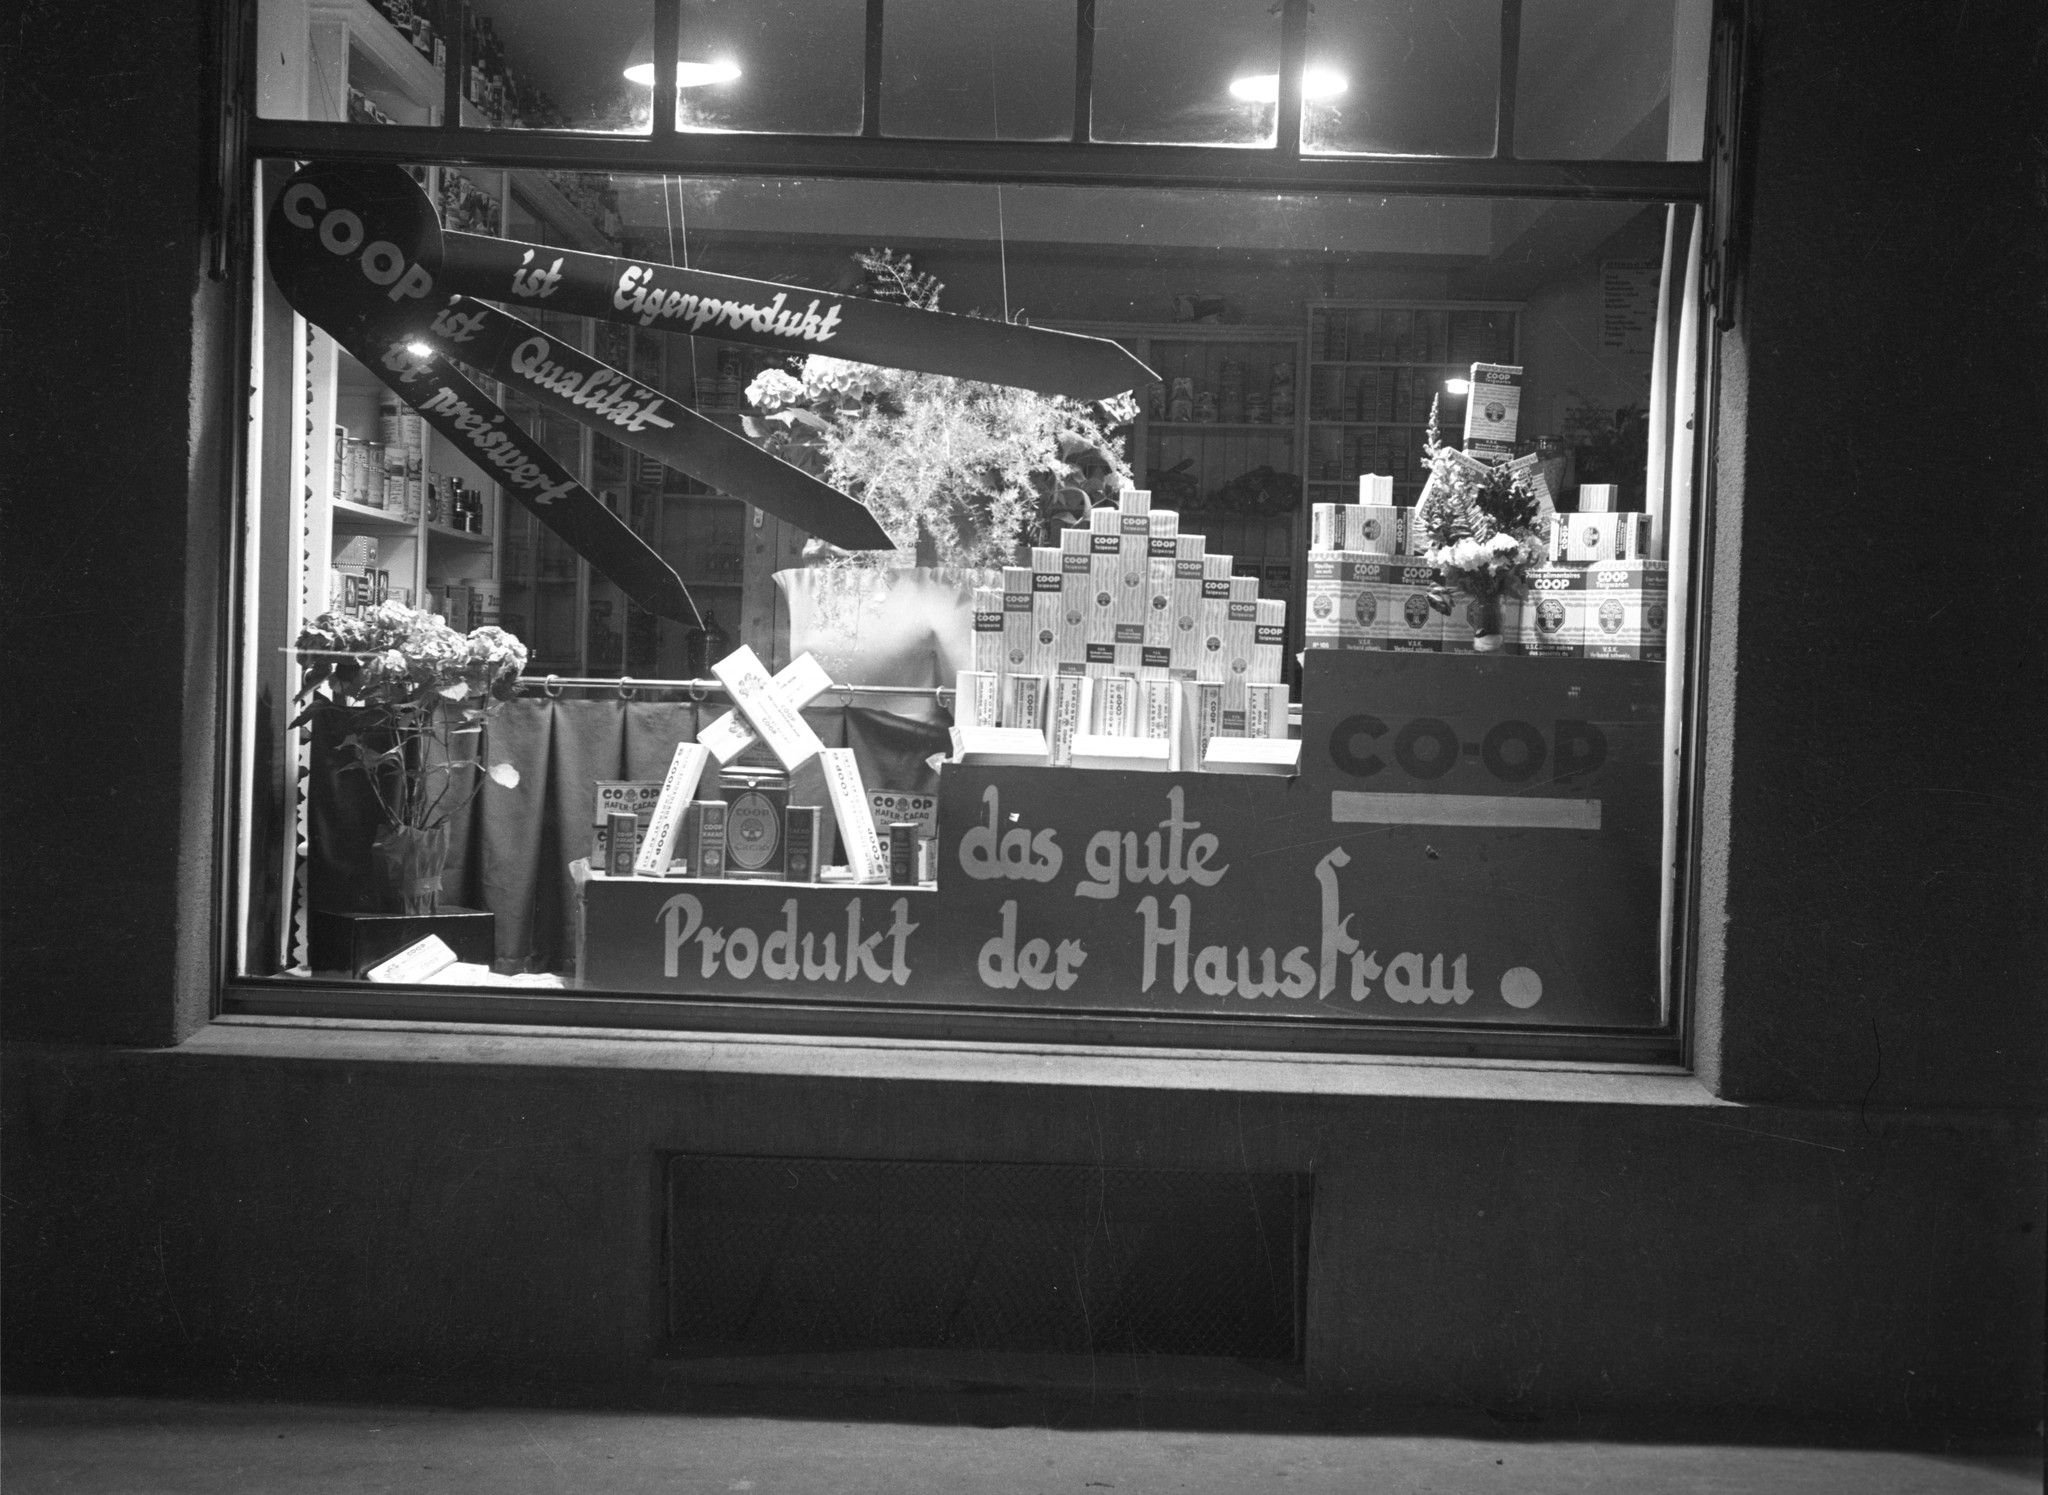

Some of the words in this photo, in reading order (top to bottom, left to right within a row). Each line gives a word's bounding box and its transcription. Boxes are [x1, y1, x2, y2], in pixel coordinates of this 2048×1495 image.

[511, 249, 563, 298] ist
[614, 266, 842, 343] Eigenprodukt
[430, 294, 488, 342] ist
[511, 337, 675, 432] Qualität
[419, 387, 578, 505] preiswert
[959, 785, 1063, 883] das
[1075, 785, 1230, 899] gute
[655, 893, 920, 986] Produkt
[978, 900, 1088, 991] der
